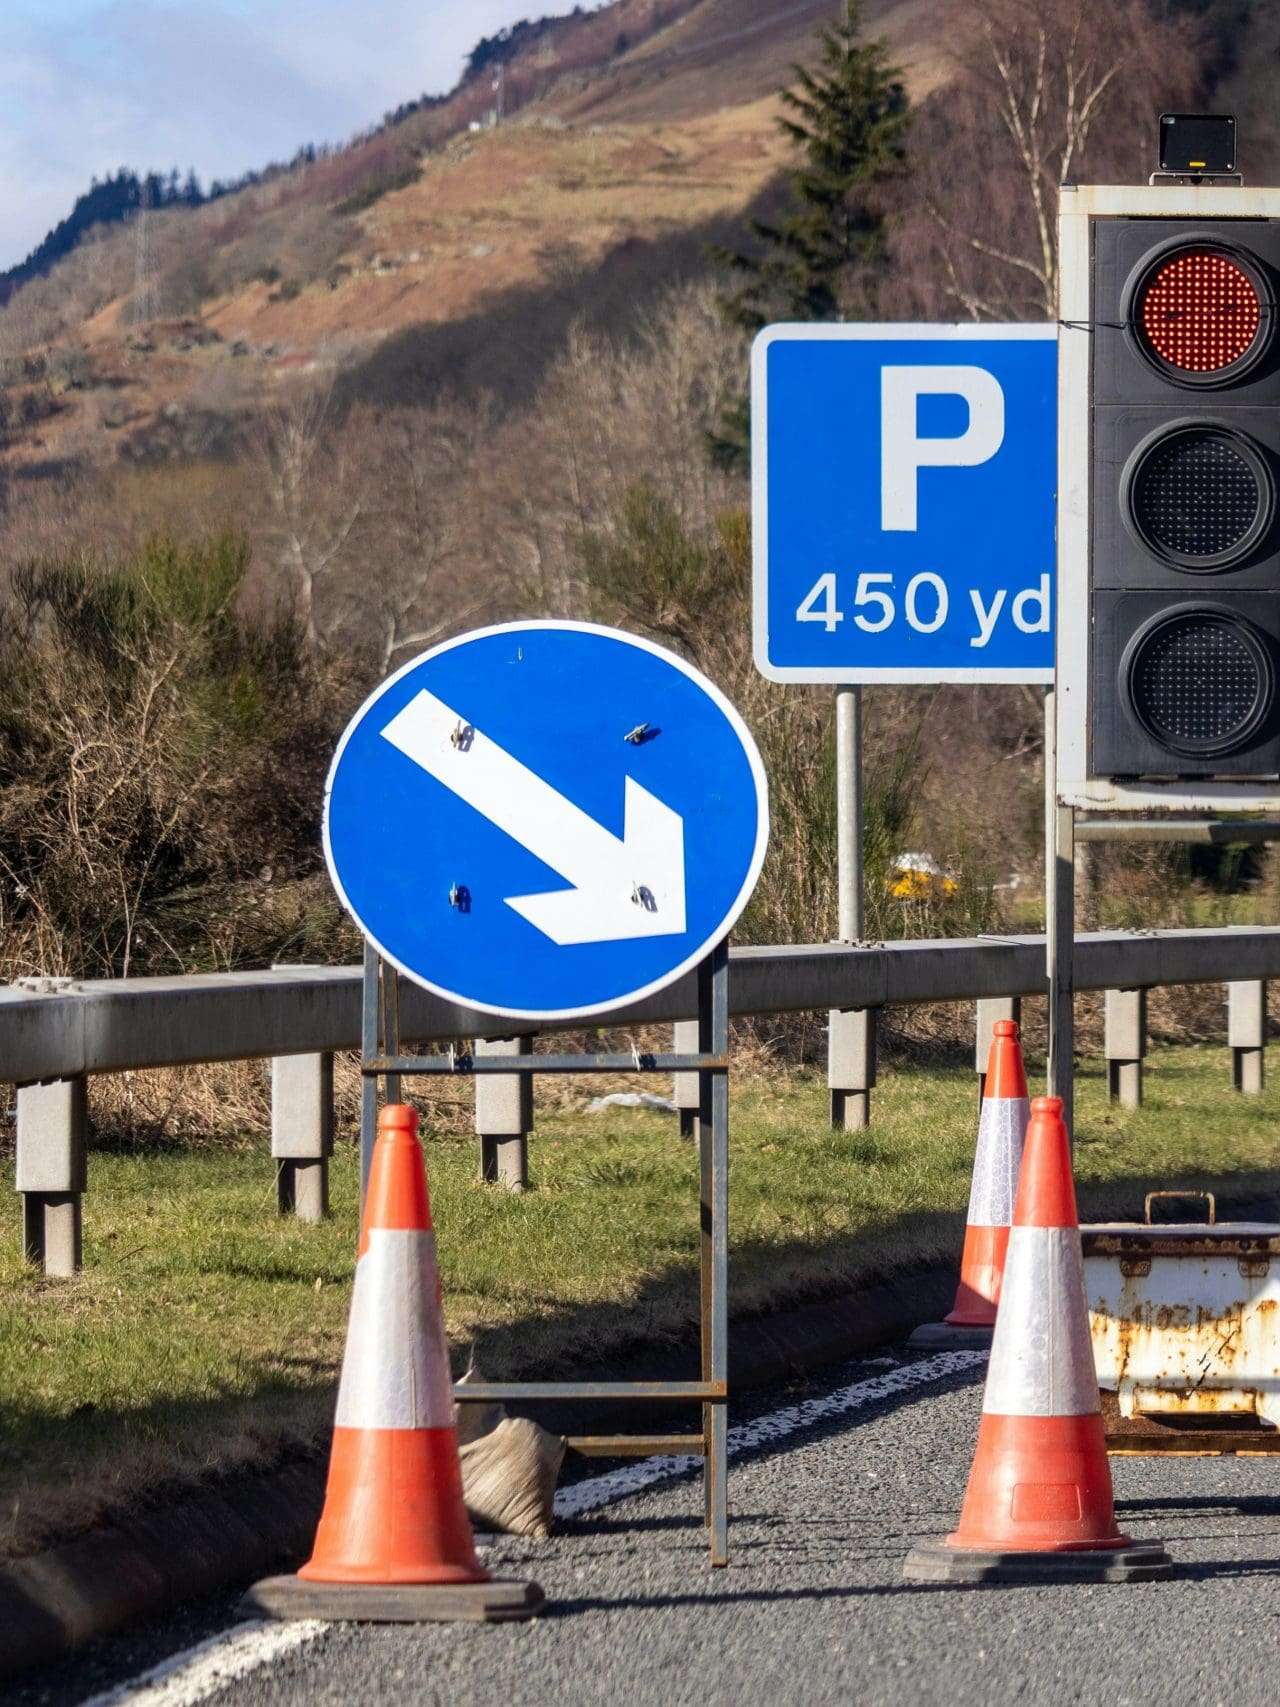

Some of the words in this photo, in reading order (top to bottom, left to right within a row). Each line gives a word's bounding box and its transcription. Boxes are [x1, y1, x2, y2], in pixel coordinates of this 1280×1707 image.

[881, 365, 1005, 531] P
[796, 572, 949, 633] 450
[969, 573, 1051, 648] yd
